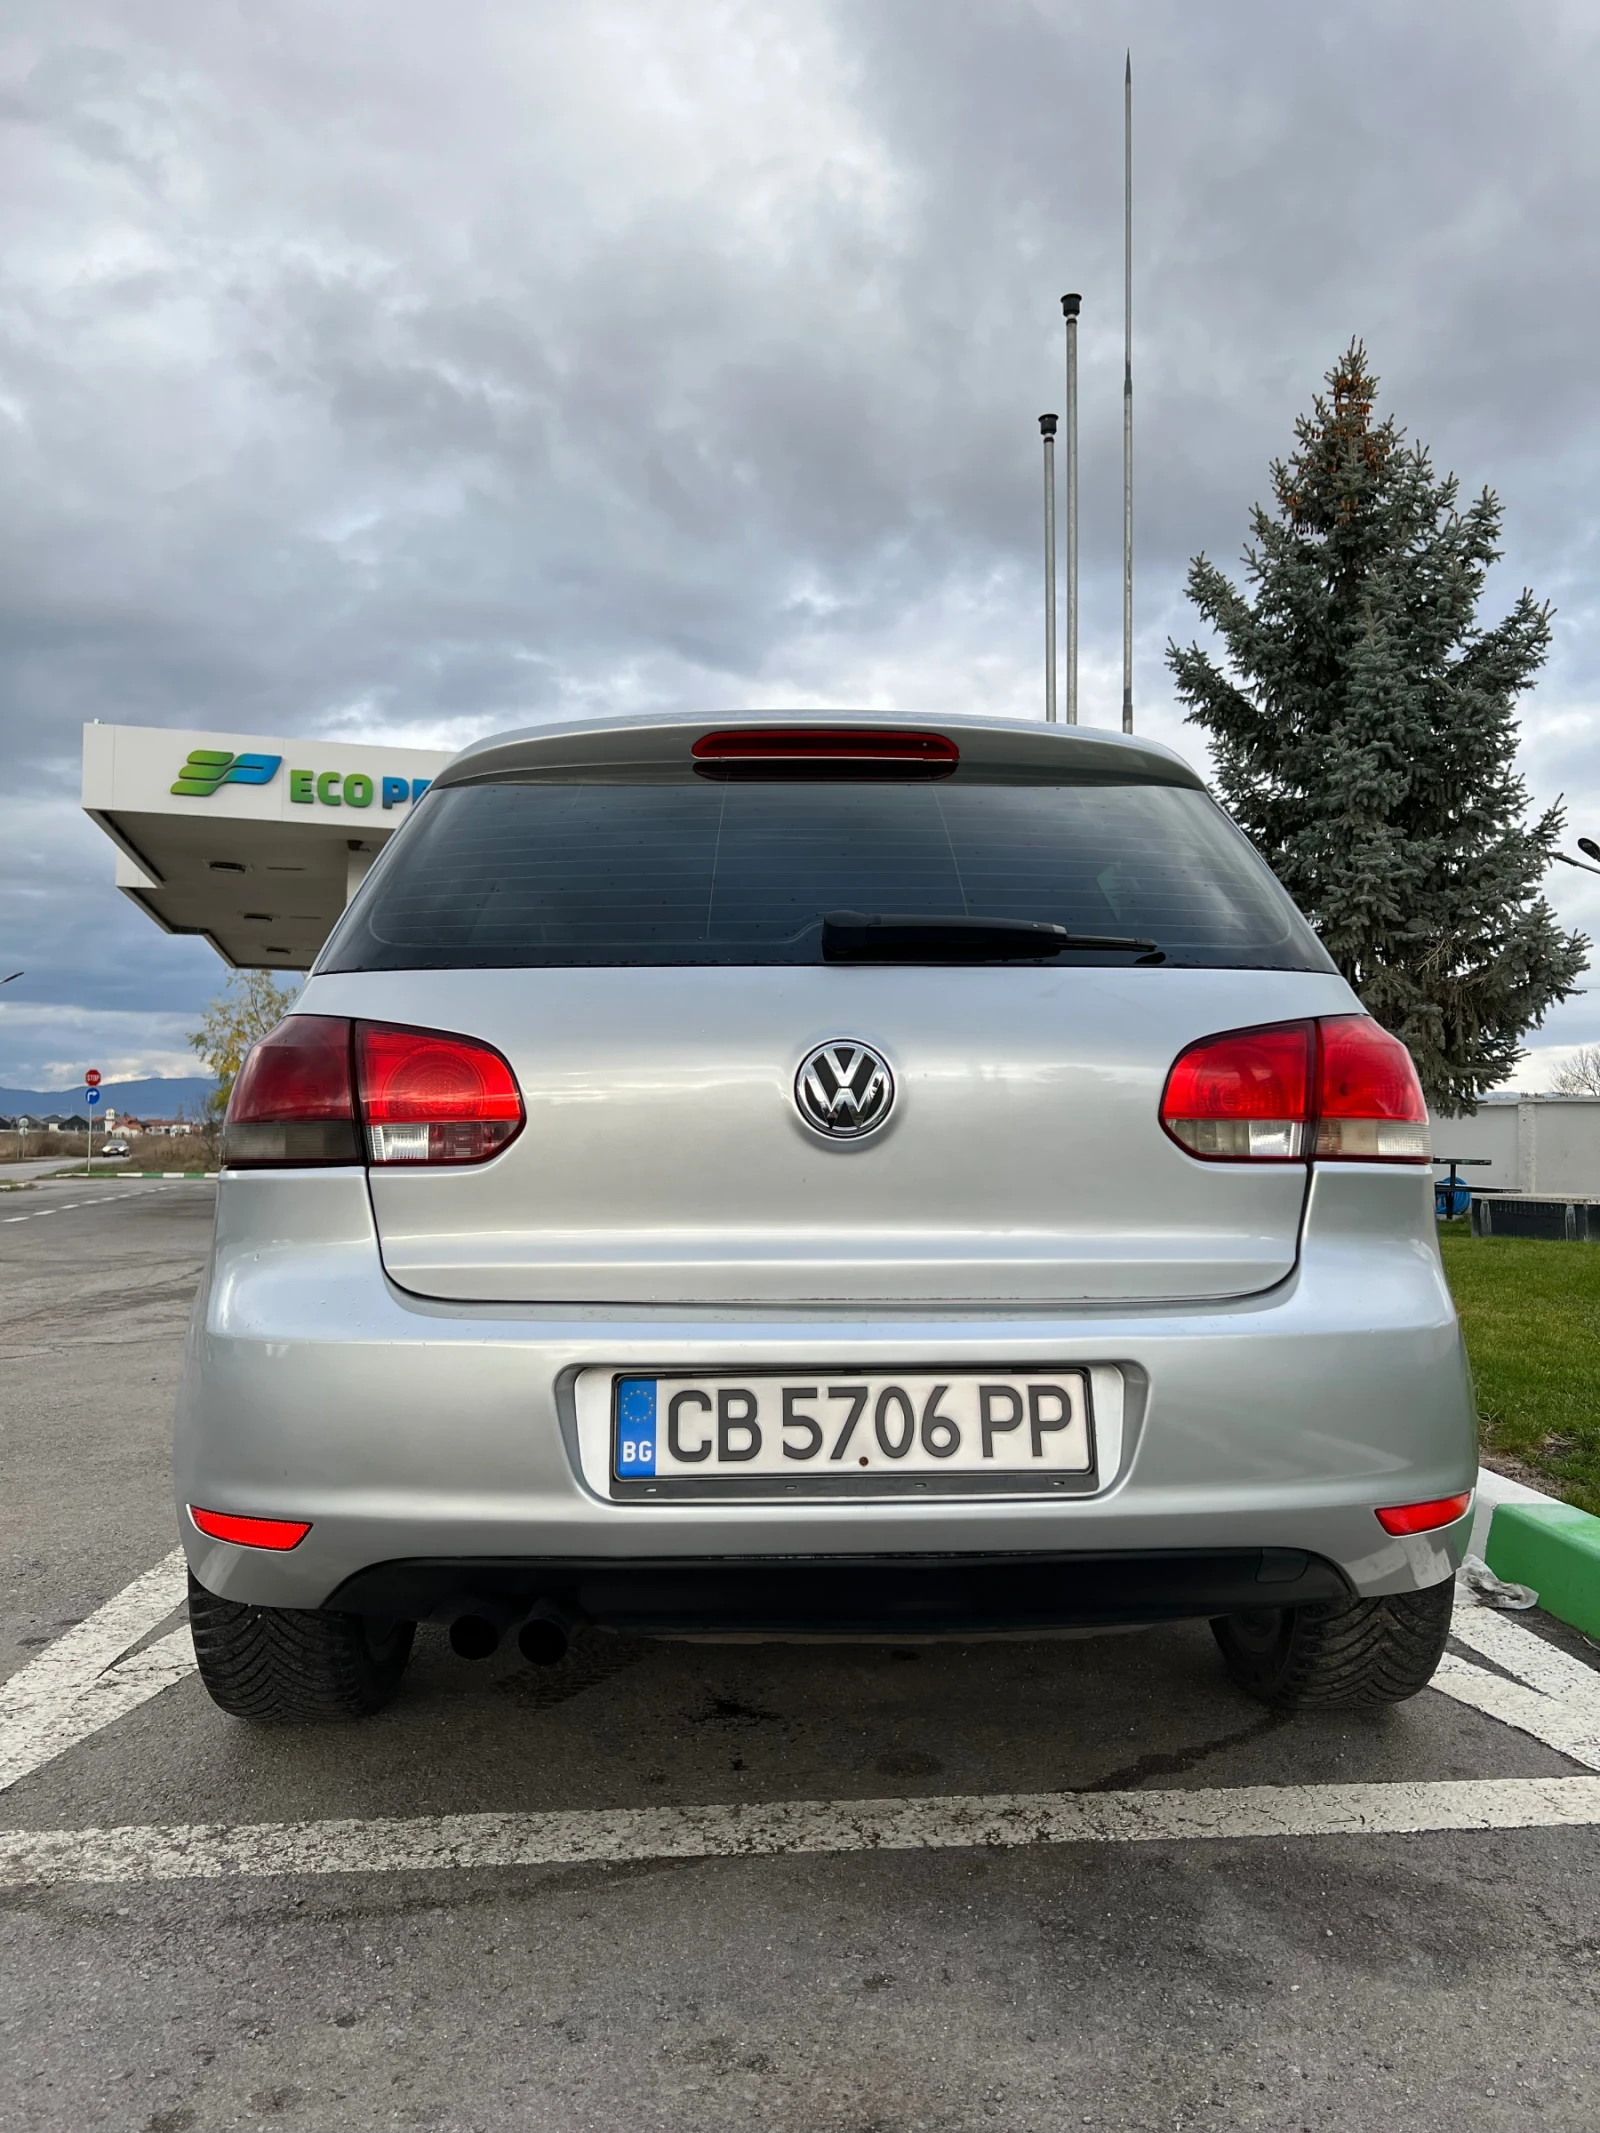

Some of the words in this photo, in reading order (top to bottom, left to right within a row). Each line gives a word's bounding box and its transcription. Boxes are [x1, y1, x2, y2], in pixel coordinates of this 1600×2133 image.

[290, 769, 373, 808] ECO
[87, 1074, 100, 1082] STOP
[800, 1044, 888, 1131] VW
[668, 1389, 762, 1462] CB
[782, 1386, 961, 1460] 5706
[979, 1385, 1072, 1458] PP
[622, 1440, 652, 1462] BG
